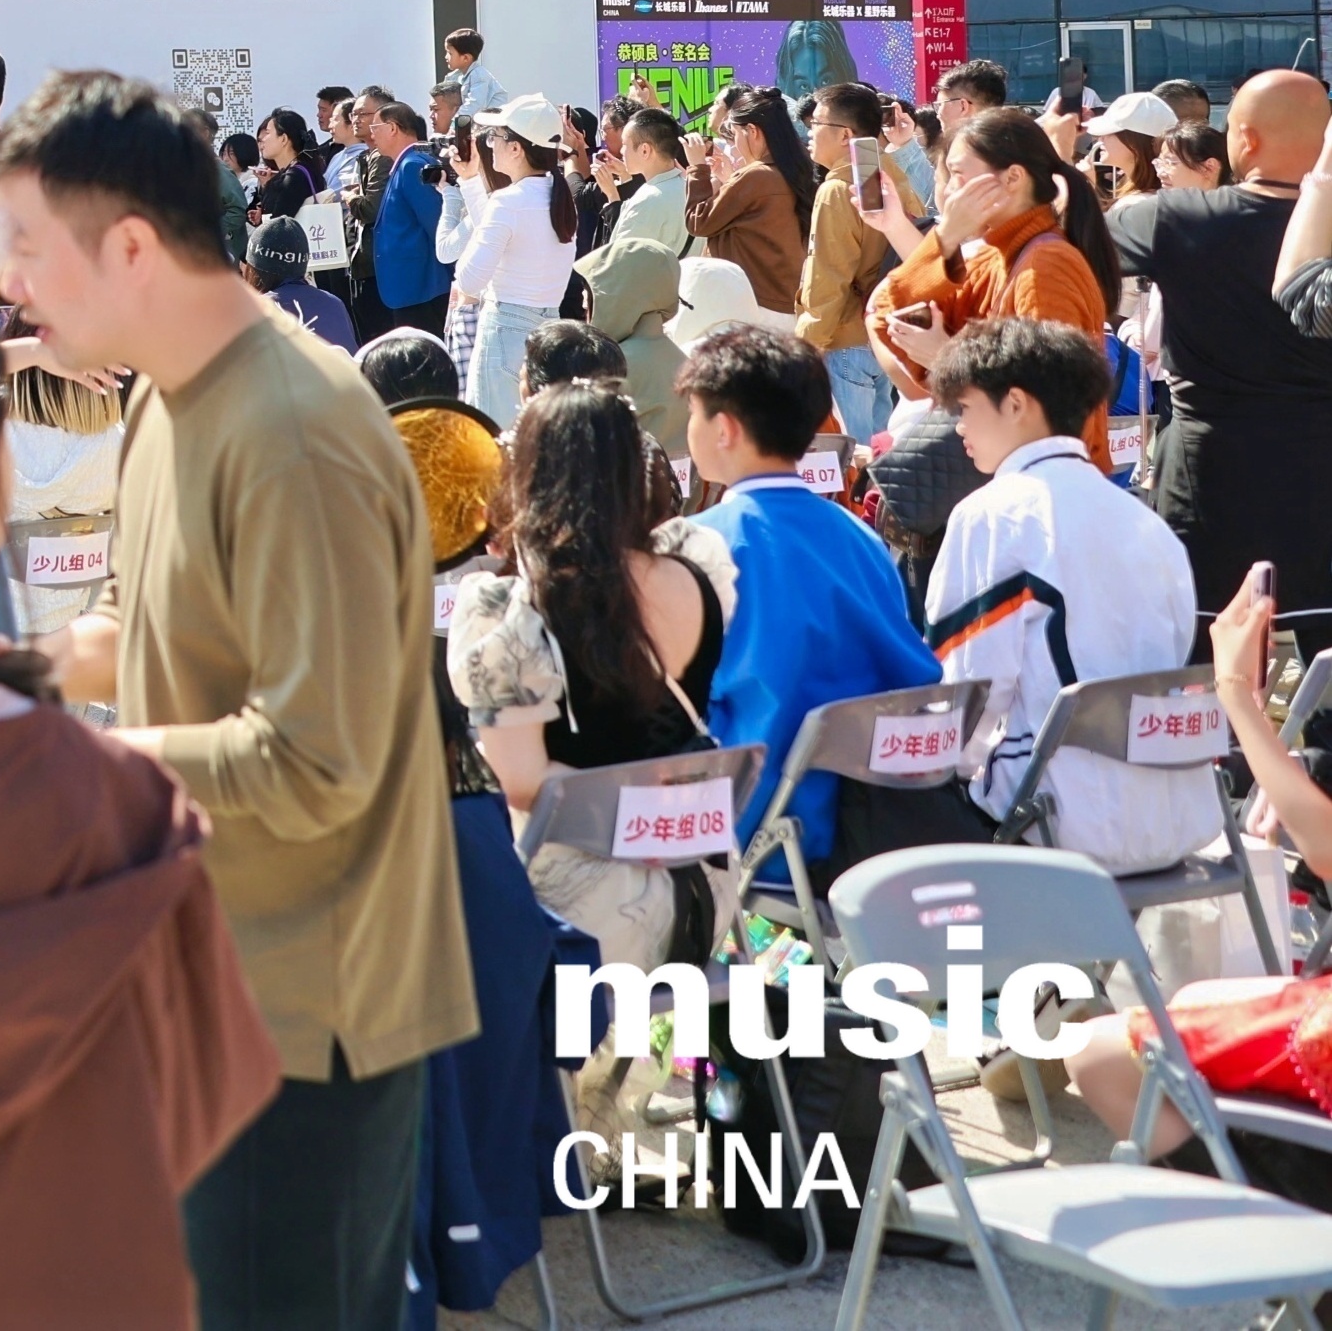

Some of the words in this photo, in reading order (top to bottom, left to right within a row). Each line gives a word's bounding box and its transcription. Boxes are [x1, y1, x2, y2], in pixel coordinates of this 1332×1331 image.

[655, 0, 686, 13] 长城乐器
[694, 0, 728, 13] Ibanez
